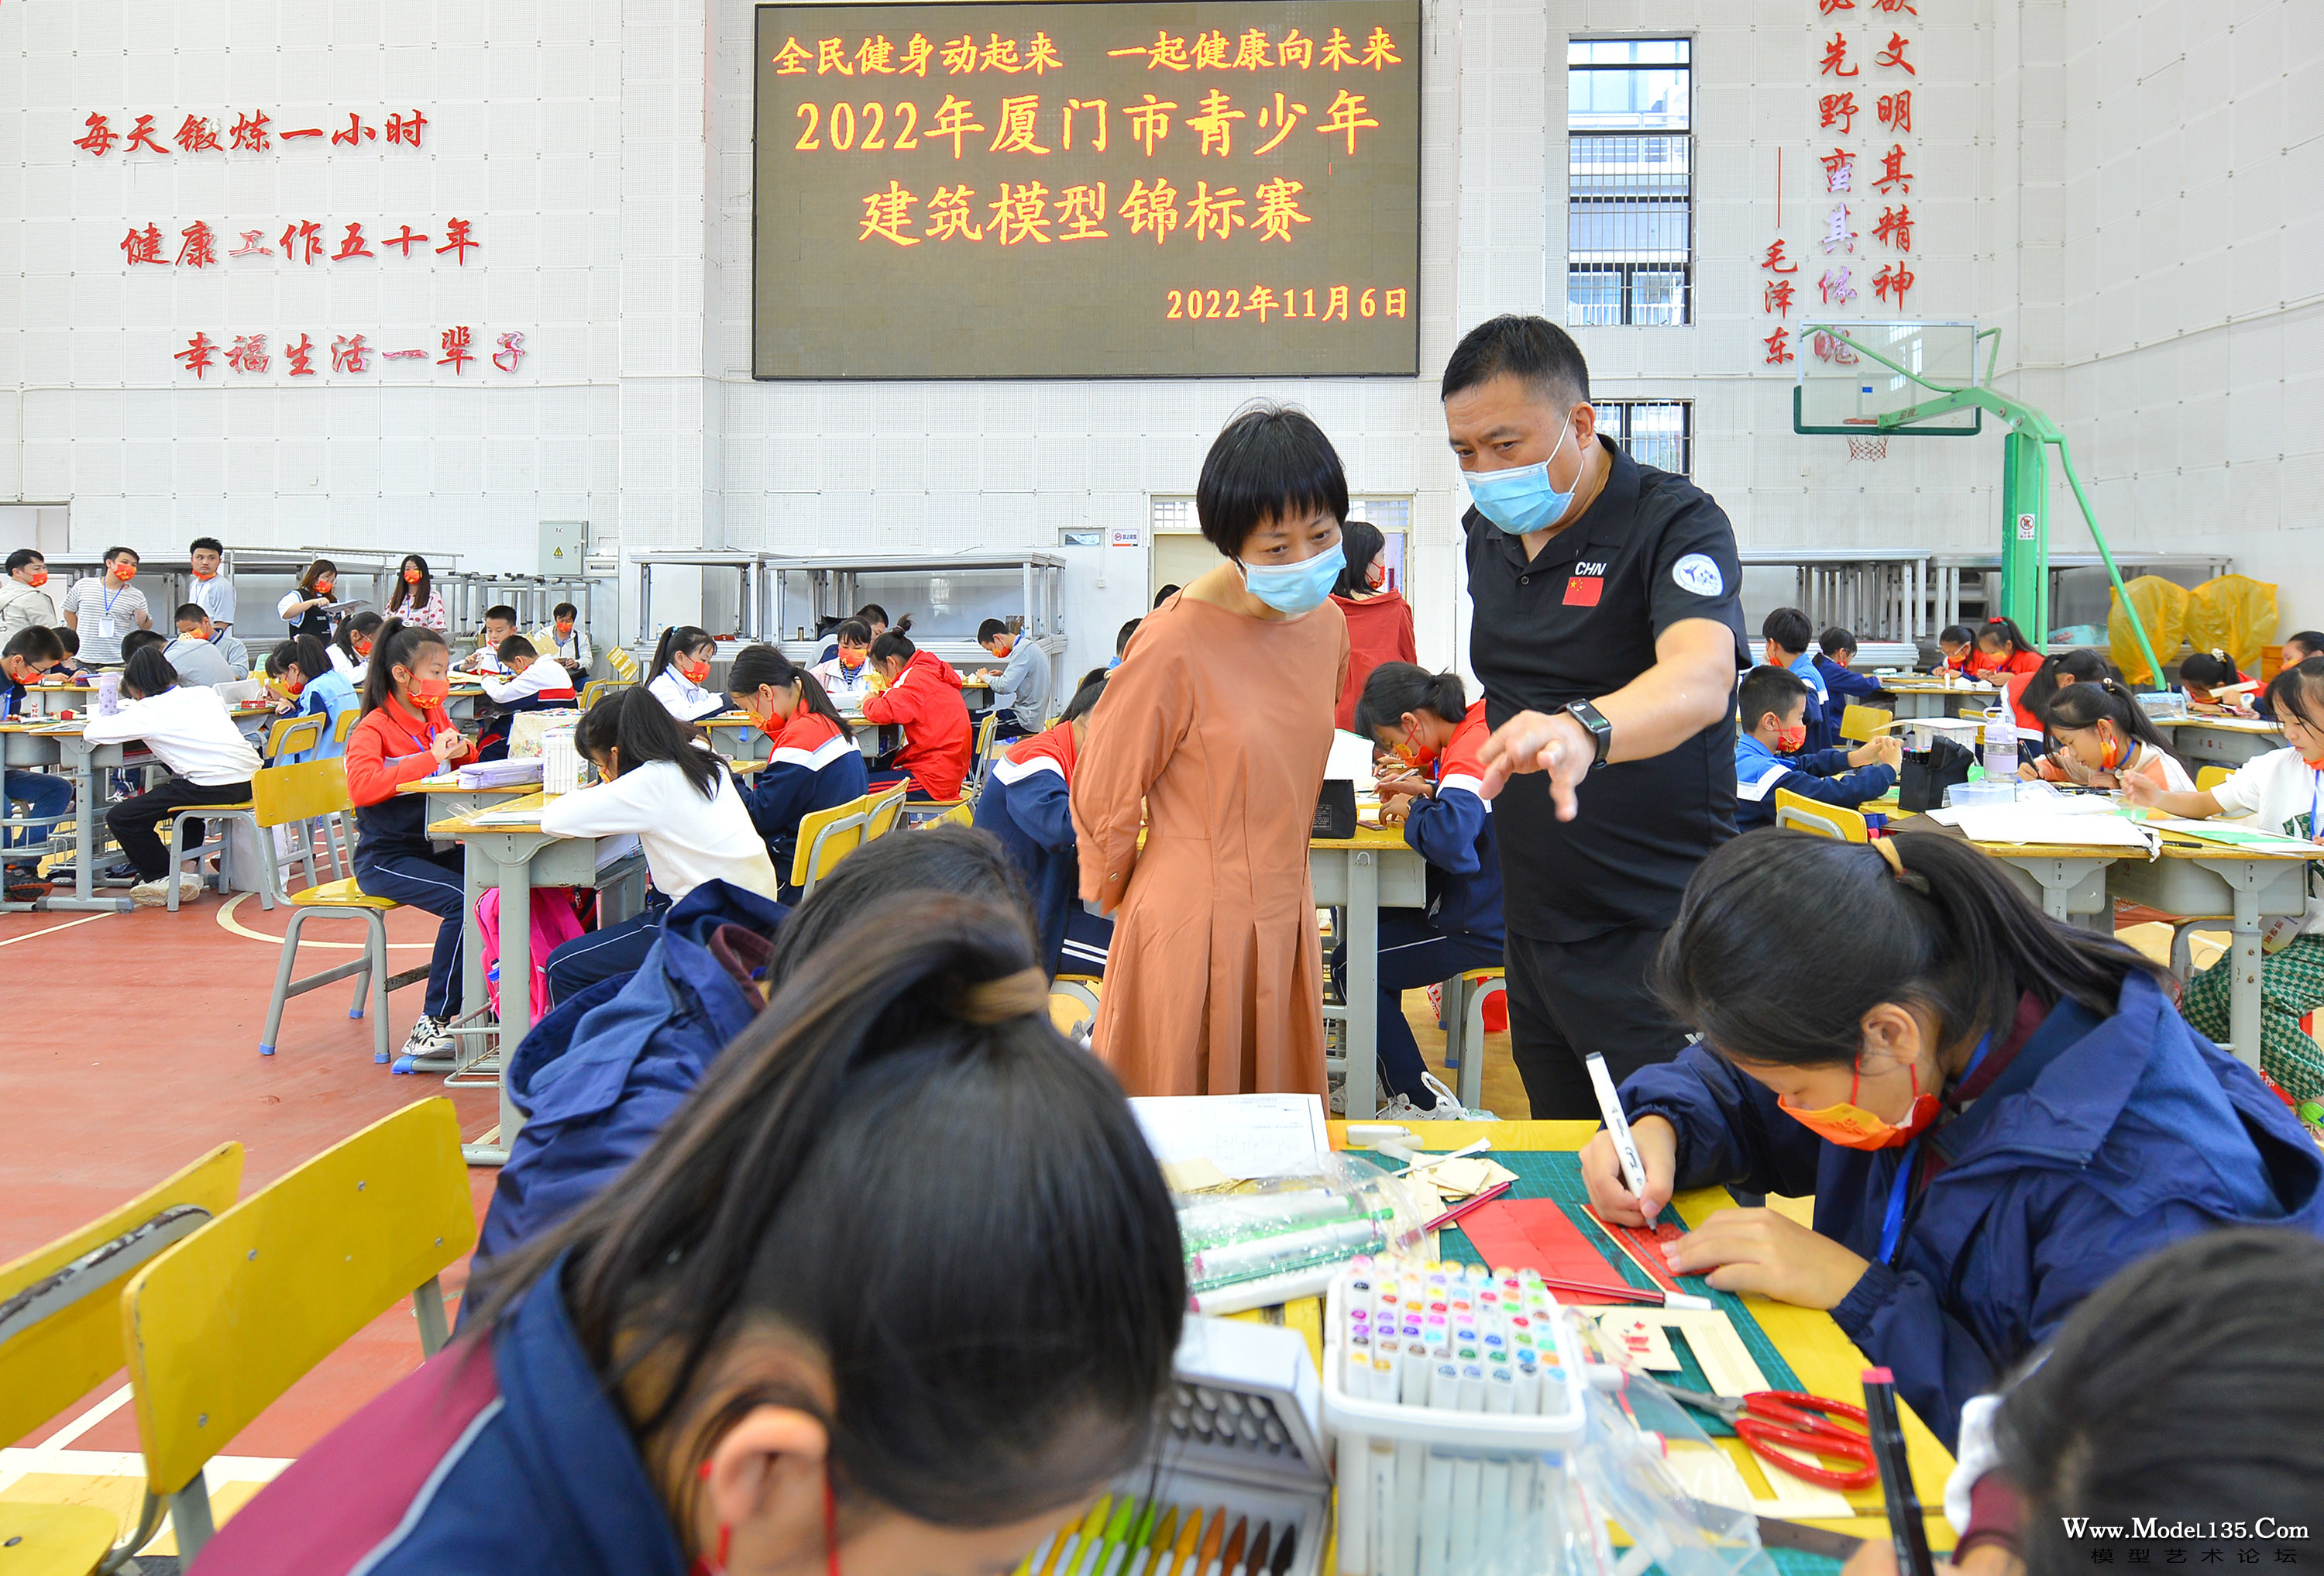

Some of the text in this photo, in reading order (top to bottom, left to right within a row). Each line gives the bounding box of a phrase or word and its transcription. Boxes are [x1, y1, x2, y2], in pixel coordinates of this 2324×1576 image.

[772, 26, 1403, 78] 全民健身动起来 一起健康向未来
[73, 108, 428, 157] 每天锻炼一小时
[795, 88, 1380, 160] 2022年厦门市青少年
[858, 177, 1312, 247] 建筑模型锦标赛
[120, 217, 480, 267] 健康工作五十年
[1166, 284, 1408, 324] 2022年11月6日
[174, 325, 526, 380] 幸福生活一辈子
[1575, 561, 1607, 576] CHN
